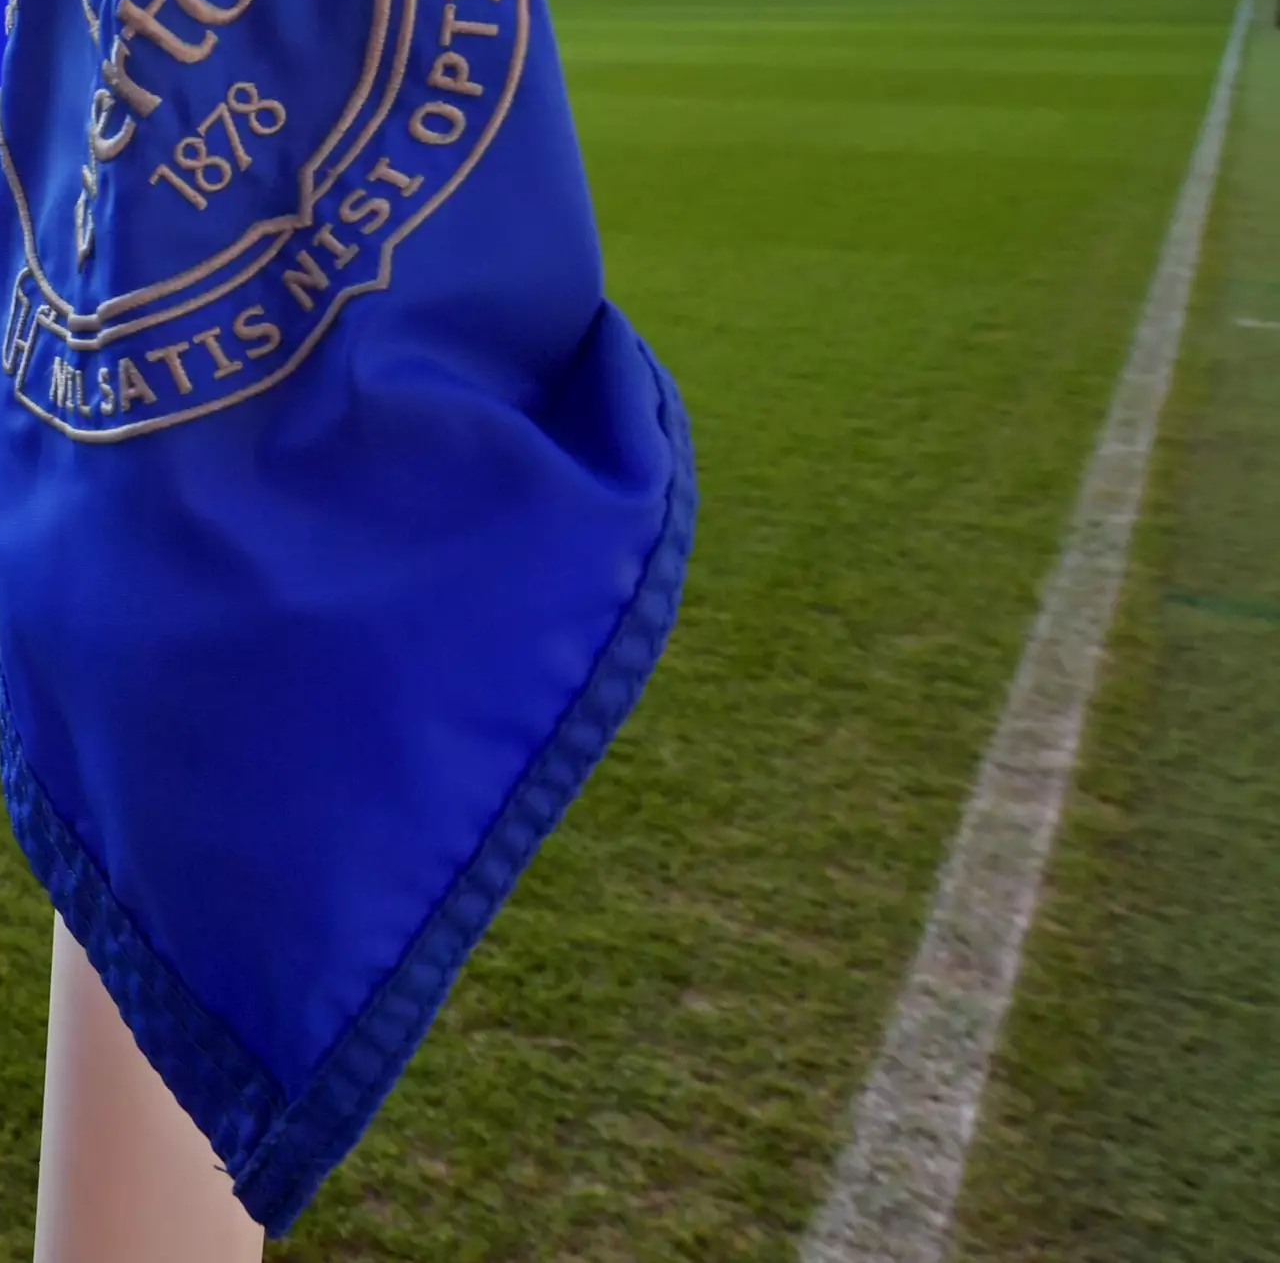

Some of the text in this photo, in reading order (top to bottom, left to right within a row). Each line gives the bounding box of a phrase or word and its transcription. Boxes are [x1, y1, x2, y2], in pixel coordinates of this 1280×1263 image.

[148, 81, 287, 212] 1878
[96, 304, 283, 417] SATIS
[281, 156, 425, 313] NISI
